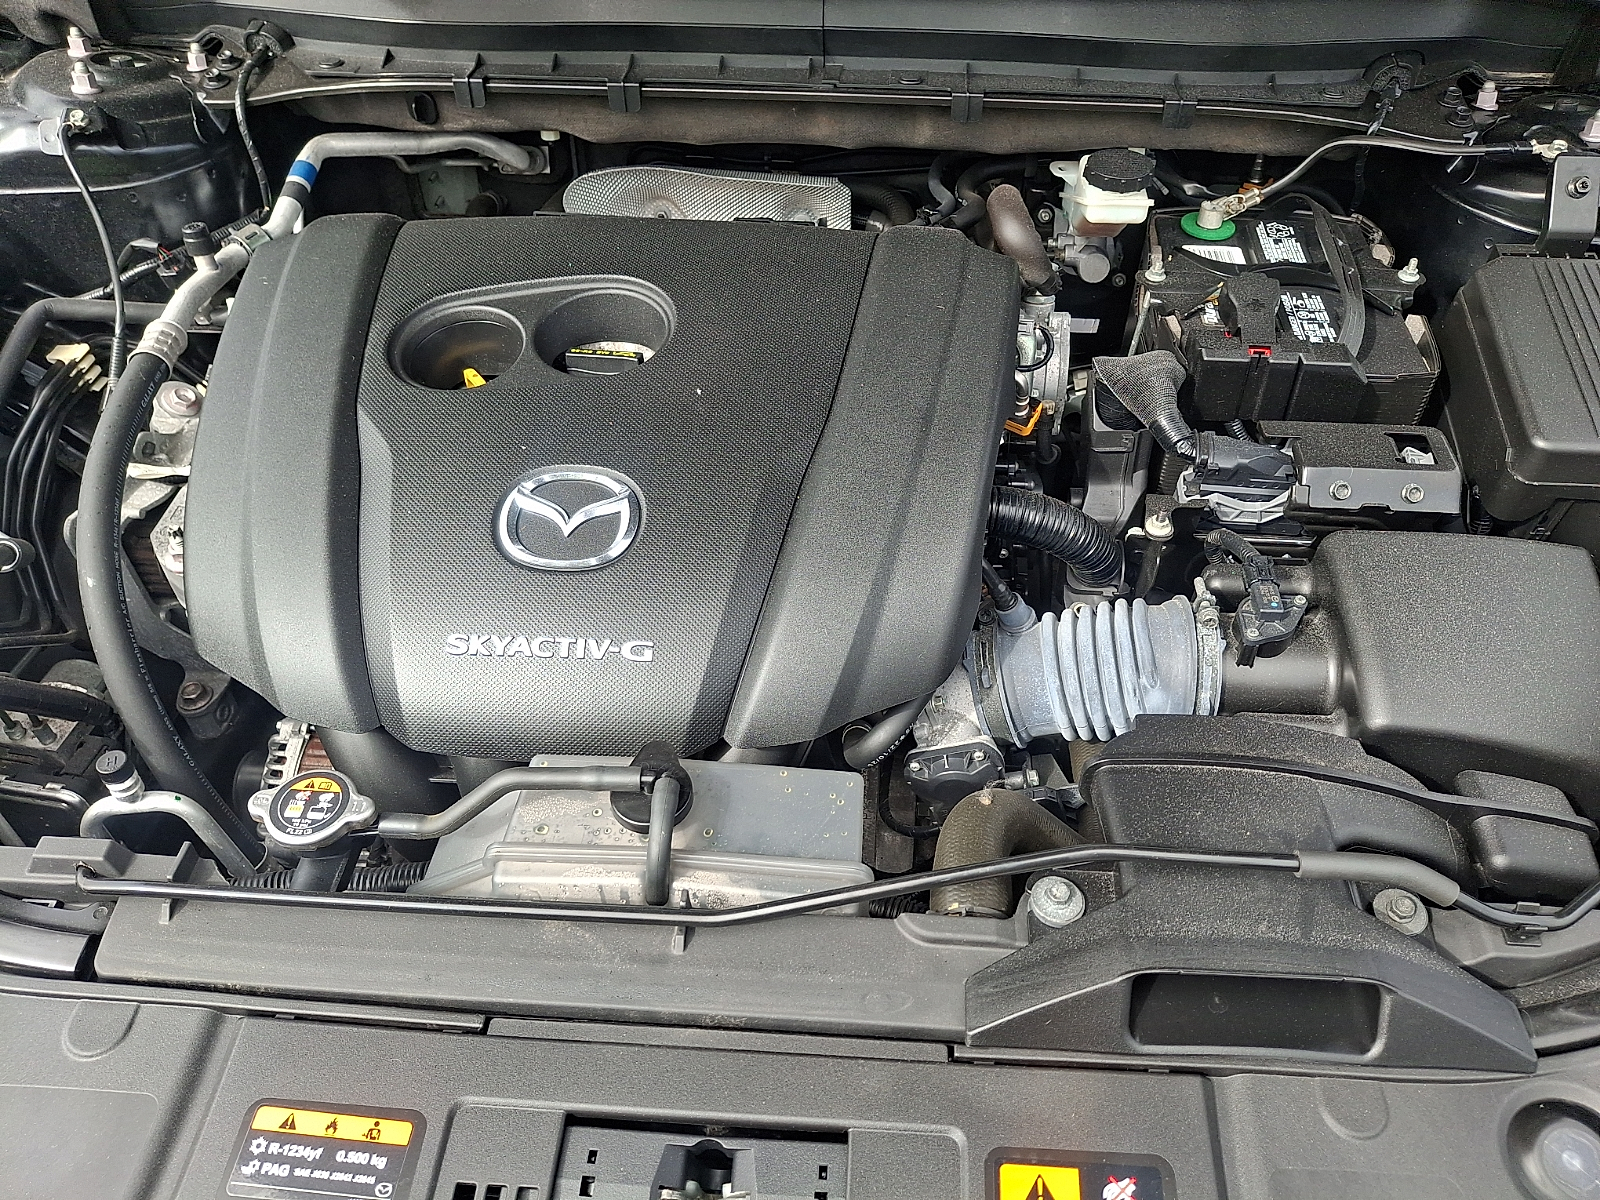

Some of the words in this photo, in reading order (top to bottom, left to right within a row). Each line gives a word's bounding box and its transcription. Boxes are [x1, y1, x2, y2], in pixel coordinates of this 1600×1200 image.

[115, 571, 125, 601] SUCTION
[446, 633, 655, 662] SKYACTIV-G
[172, 734, 195, 767] GALAXY
[351, 800, 367, 812] 1.1
[260, 1161, 290, 1177] PAG
[268, 1141, 324, 1161] R-1234yf
[335, 1150, 370, 1165] 0.500
[370, 1152, 387, 1169] kg
